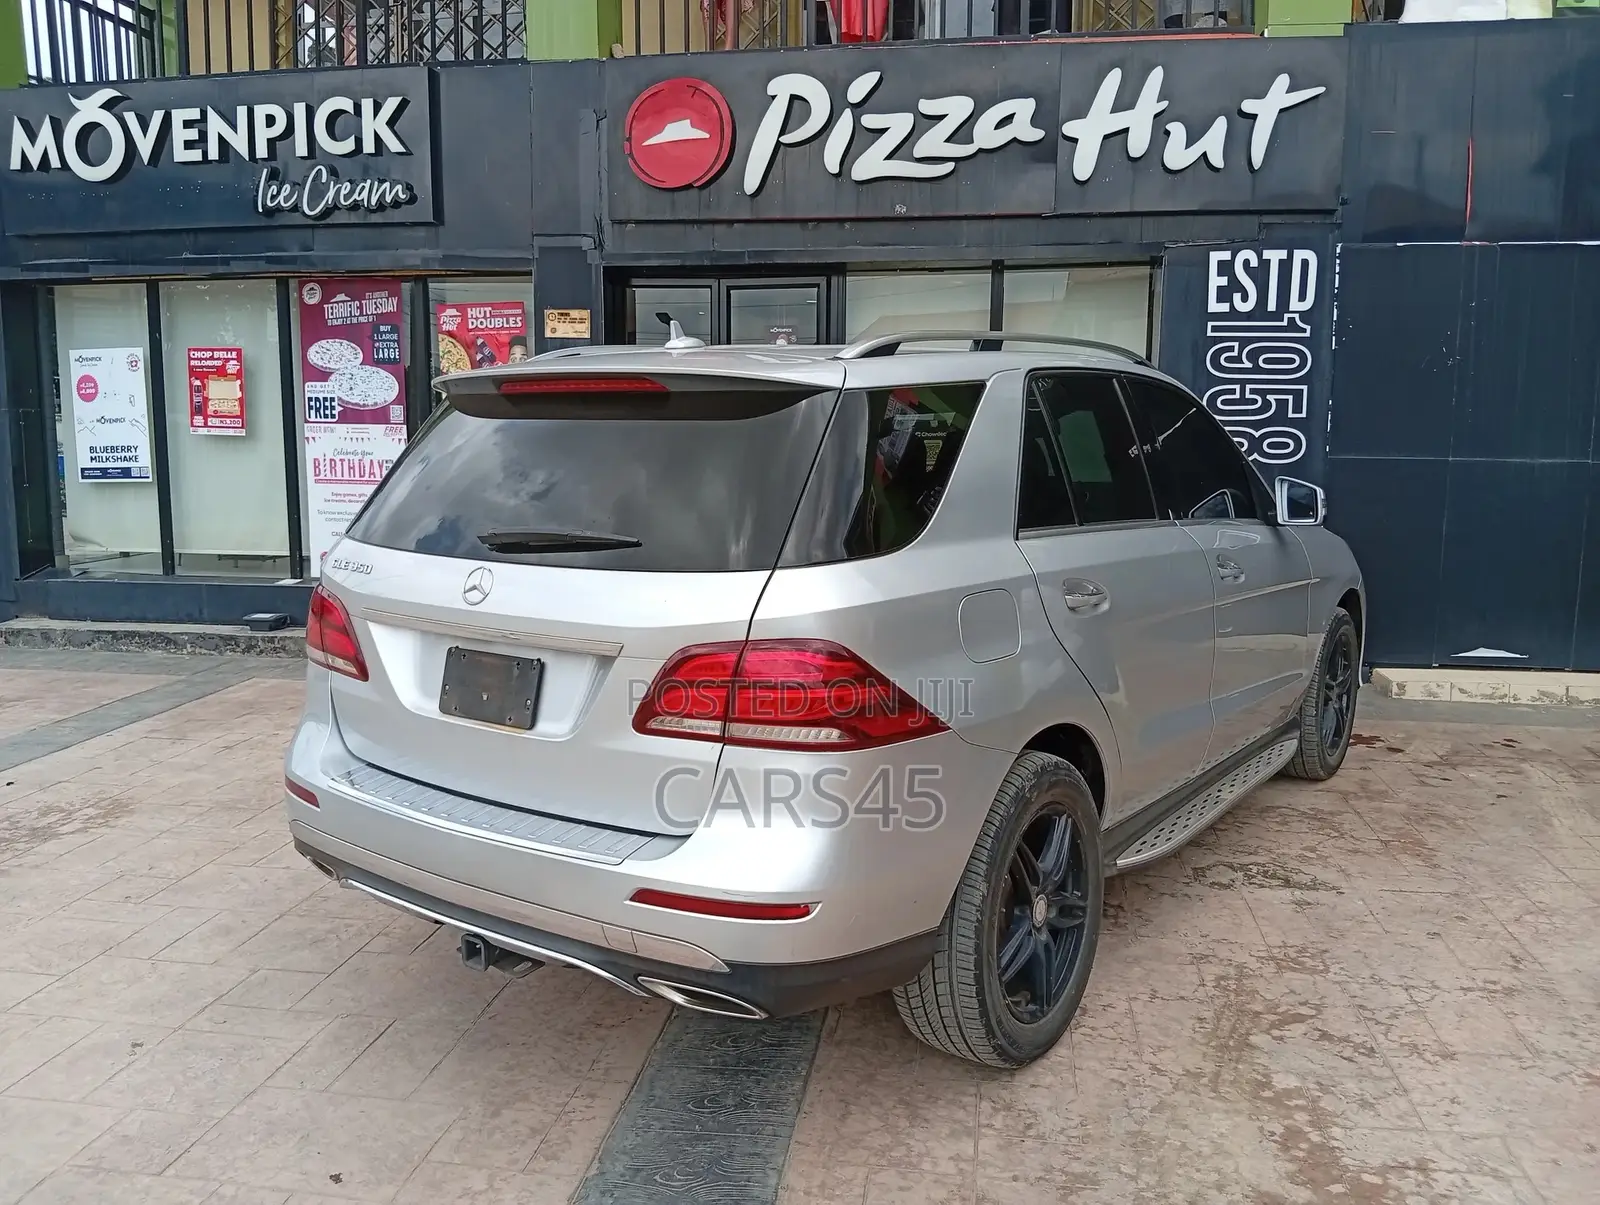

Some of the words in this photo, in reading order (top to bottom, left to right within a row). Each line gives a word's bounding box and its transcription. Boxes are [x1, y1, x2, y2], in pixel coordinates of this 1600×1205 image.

[744, 71, 1045, 196] Pizza
[1062, 66, 1326, 183] Hut
[256, 167, 299, 213] Ice
[302, 165, 408, 216] Cream
[1207, 249, 1318, 312] ESTD
[323, 301, 360, 319] TERRIFIC
[361, 297, 398, 315] TUESDAY
[467, 307, 492, 318] HUT
[440, 315, 461, 327] Pizza
[441, 323, 458, 331] Hut
[468, 317, 522, 329] DOUBLES
[374, 348, 399, 359] LARGE
[307, 397, 336, 419] FREE
[384, 425, 404, 433] FREE
[89, 445, 139, 454] BLUEBERRY
[90, 455, 139, 463] MILKSHAKE
[313, 453, 384, 479] BIRTHDAY
